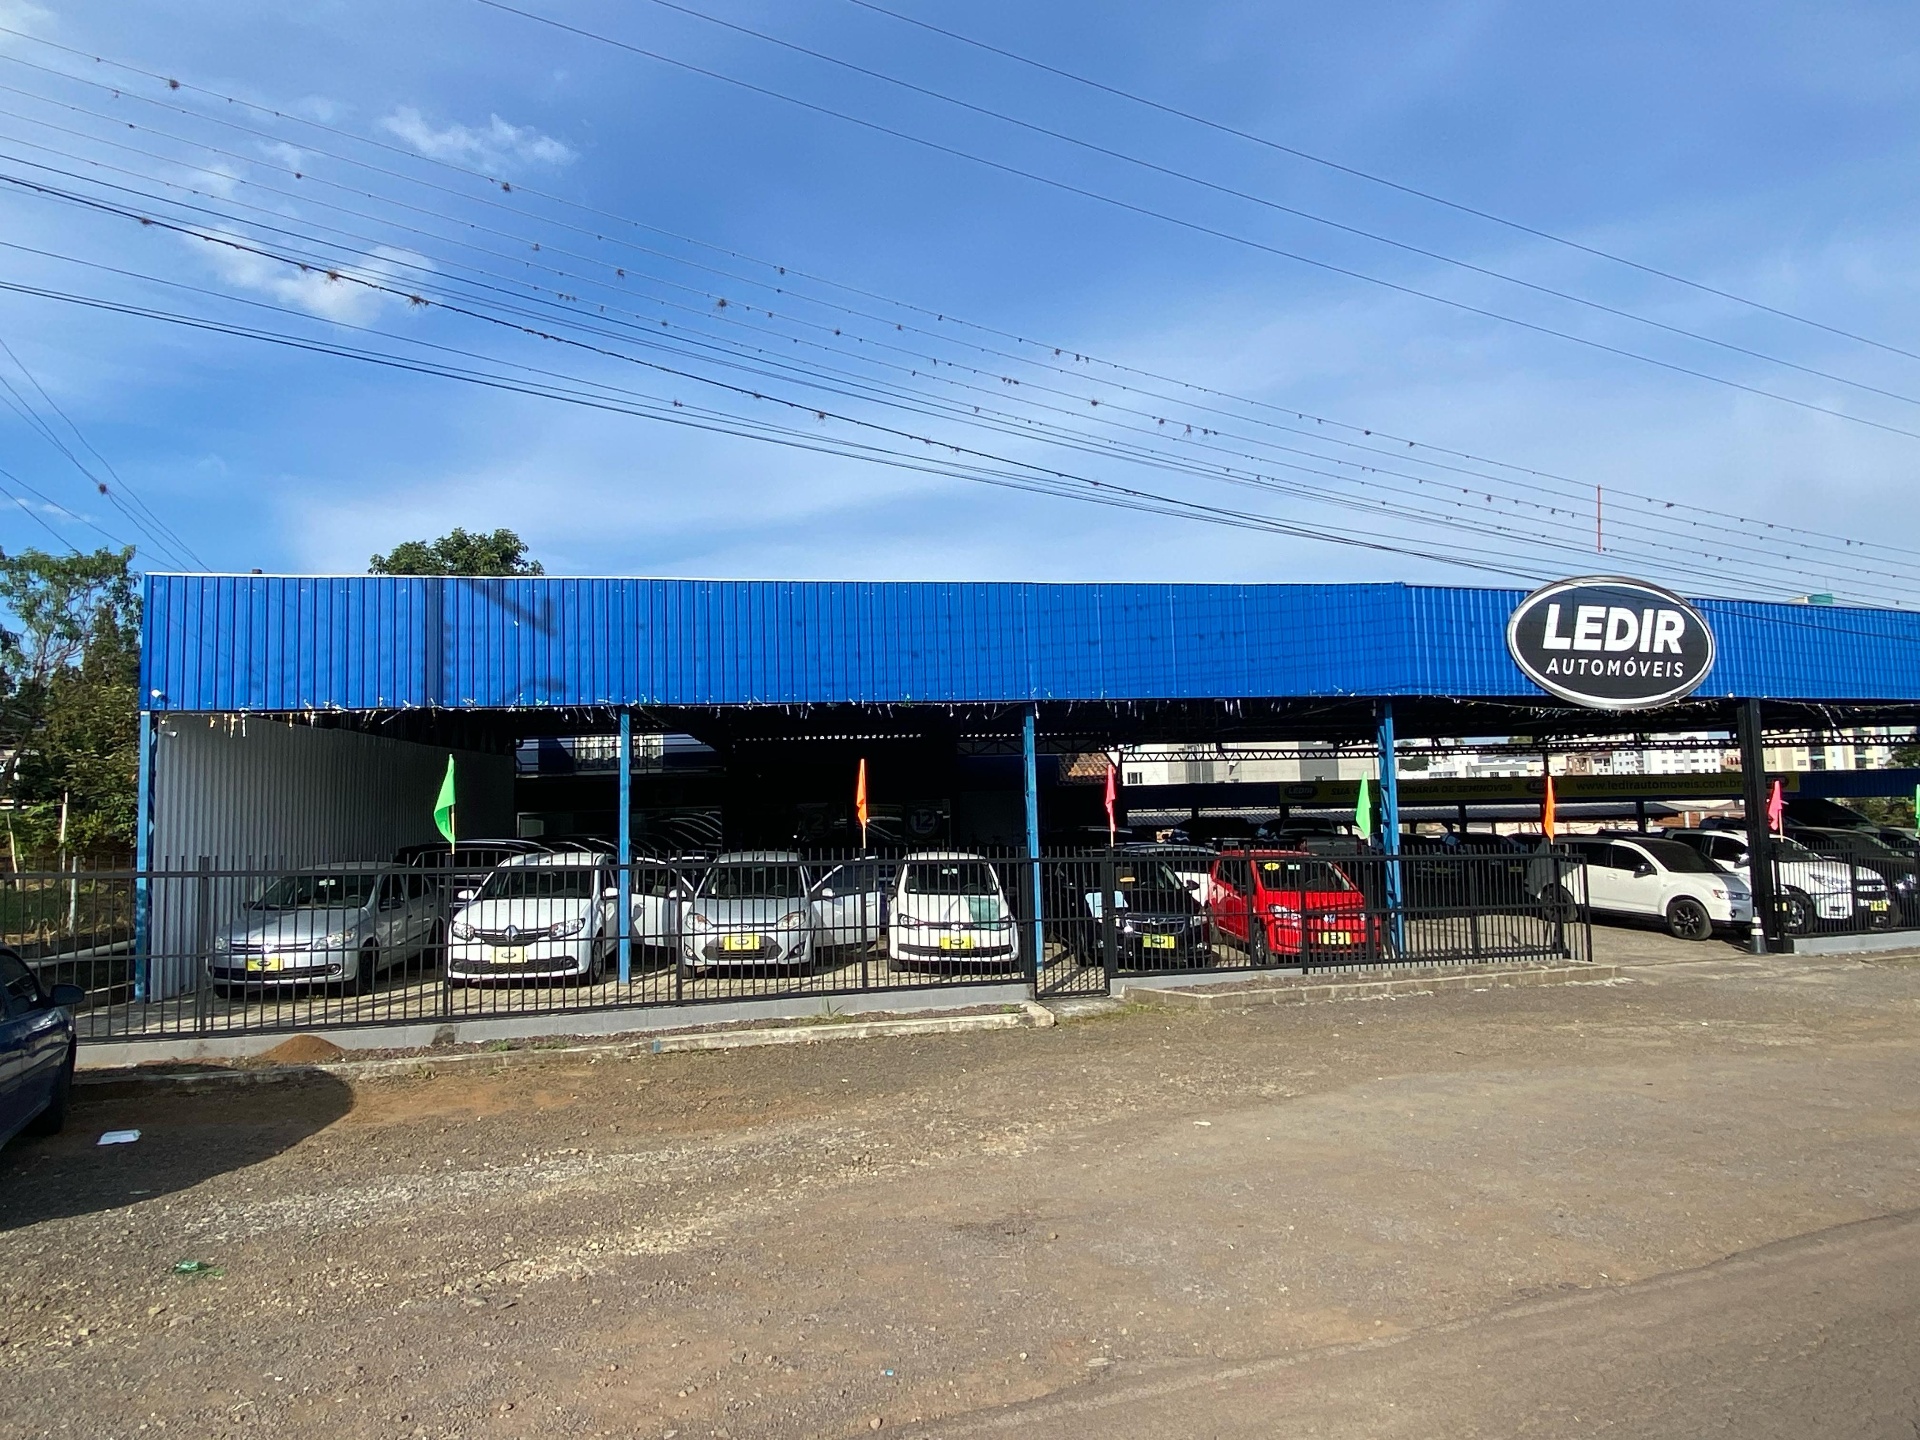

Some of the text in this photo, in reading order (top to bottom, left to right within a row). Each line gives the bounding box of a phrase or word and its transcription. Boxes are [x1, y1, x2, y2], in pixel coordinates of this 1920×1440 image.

[1542, 603, 1685, 654] LEDIR
[1545, 656, 1684, 678] AUTOMÓVEIS
[1330, 787, 1350, 796] SUA
[1441, 785, 1456, 793] DE
[1457, 784, 1512, 793] SEMINOVOS
[1576, 779, 1741, 790] www.ledirautomoveis.com.br
